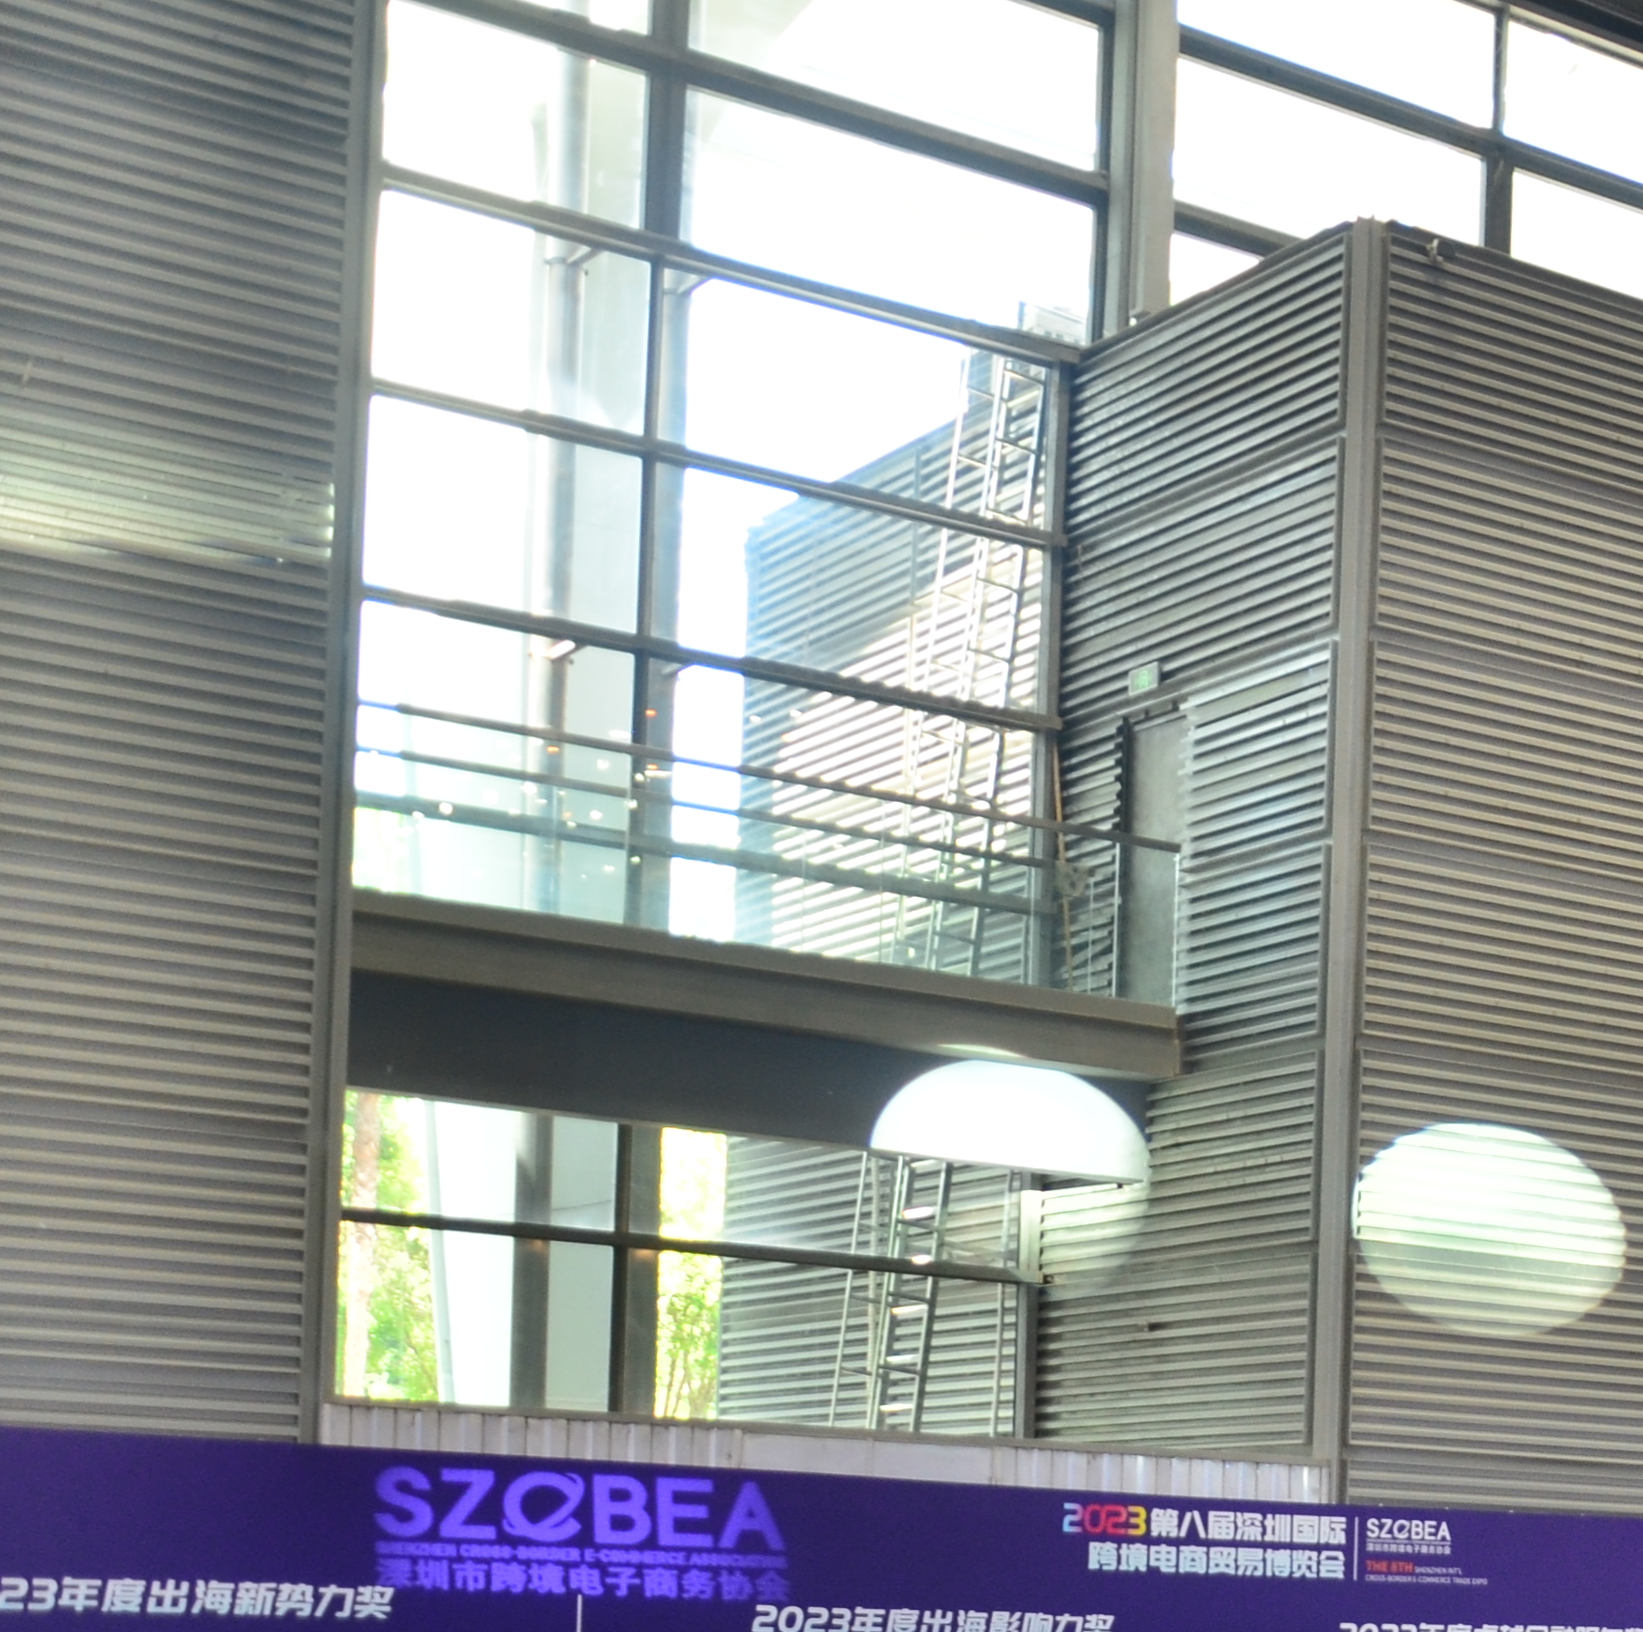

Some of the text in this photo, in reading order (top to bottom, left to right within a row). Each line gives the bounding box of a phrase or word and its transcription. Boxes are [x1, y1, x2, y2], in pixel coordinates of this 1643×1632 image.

[376, 1558, 790, 1601] 深圳市跨境电子商务协会
[1087, 1540, 1345, 1580] 跨境电商贸易博览会
